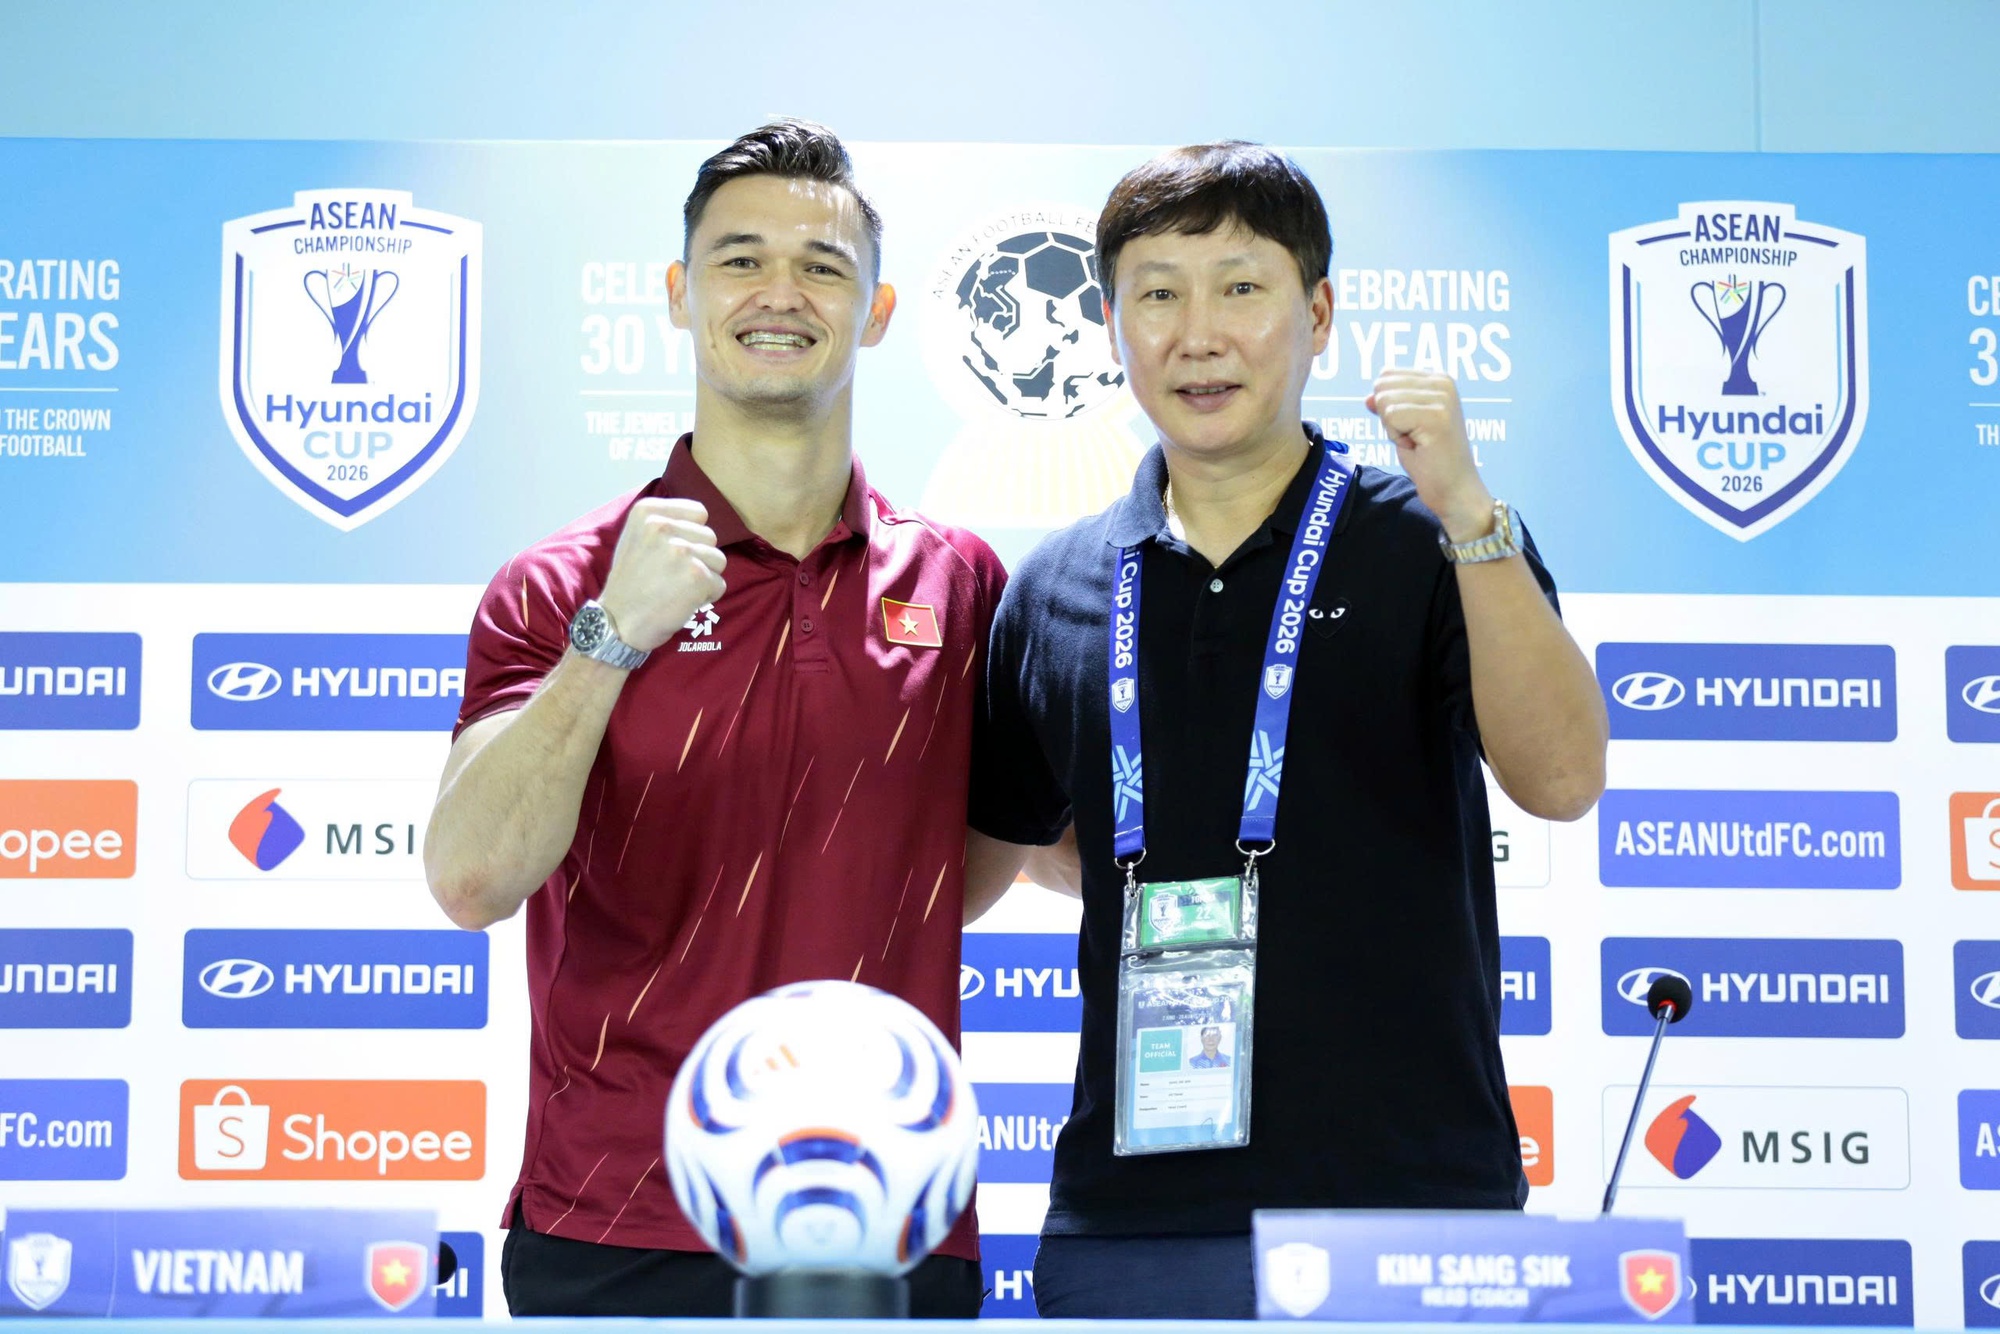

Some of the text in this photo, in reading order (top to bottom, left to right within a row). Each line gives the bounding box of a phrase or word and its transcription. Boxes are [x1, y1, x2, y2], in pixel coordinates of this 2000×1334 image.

[309, 201, 397, 231] ASEAN
[1694, 213, 1781, 243] ASEAN
[293, 236, 413, 255] CHAMPIONSHIP
[1679, 247, 1798, 267] CHAMPIONSHIP
[0, 259, 120, 301] RATING
[932, 244, 972, 300] ASAN
[1334, 269, 1510, 312] EBRATING
[0, 311, 120, 371] EARS
[580, 314, 645, 375] 30
[1349, 321, 1512, 382] YEARS
[5, 408, 111, 431] THE CROWN
[265, 391, 433, 429] Hyundai
[584, 411, 621, 435] THE
[622, 411, 678, 435] JEWEL
[1658, 403, 1824, 440] Hyundai
[0, 434, 87, 457] FOOTBALL
[302, 431, 394, 460] CUP
[608, 437, 634, 461] OF
[1353, 443, 1391, 467] EAN
[1696, 441, 1787, 471] CUP
[327, 465, 369, 482] 2026
[1721, 476, 1763, 492] 2026
[1302, 468, 1348, 547] Hyundai
[1114, 561, 1138, 609] Cup
[1286, 549, 1319, 596] Cup
[1115, 611, 1135, 669] 2026
[1275, 598, 1305, 655] 2026
[0, 666, 127, 697] UNDAI
[292, 667, 466, 697] HYUNDA
[1695, 677, 1882, 708] HYUNDAI
[0, 829, 123, 873] opee
[326, 823, 414, 855] MSI
[1614, 820, 1885, 858] ASEANUtdFC.com
[285, 964, 474, 994] HYUNDAI
[1702, 973, 1889, 1003] HYUNDAI
[1144, 1051, 1176, 1059] OFFICIAL
[282, 1113, 473, 1175] Shopee
[1742, 1131, 1869, 1164] MSIG
[132, 1249, 304, 1294] VIETNAM
[1377, 1254, 1572, 1287] KIM SANG SIK
[1708, 1274, 1898, 1305] HYUNDAI
